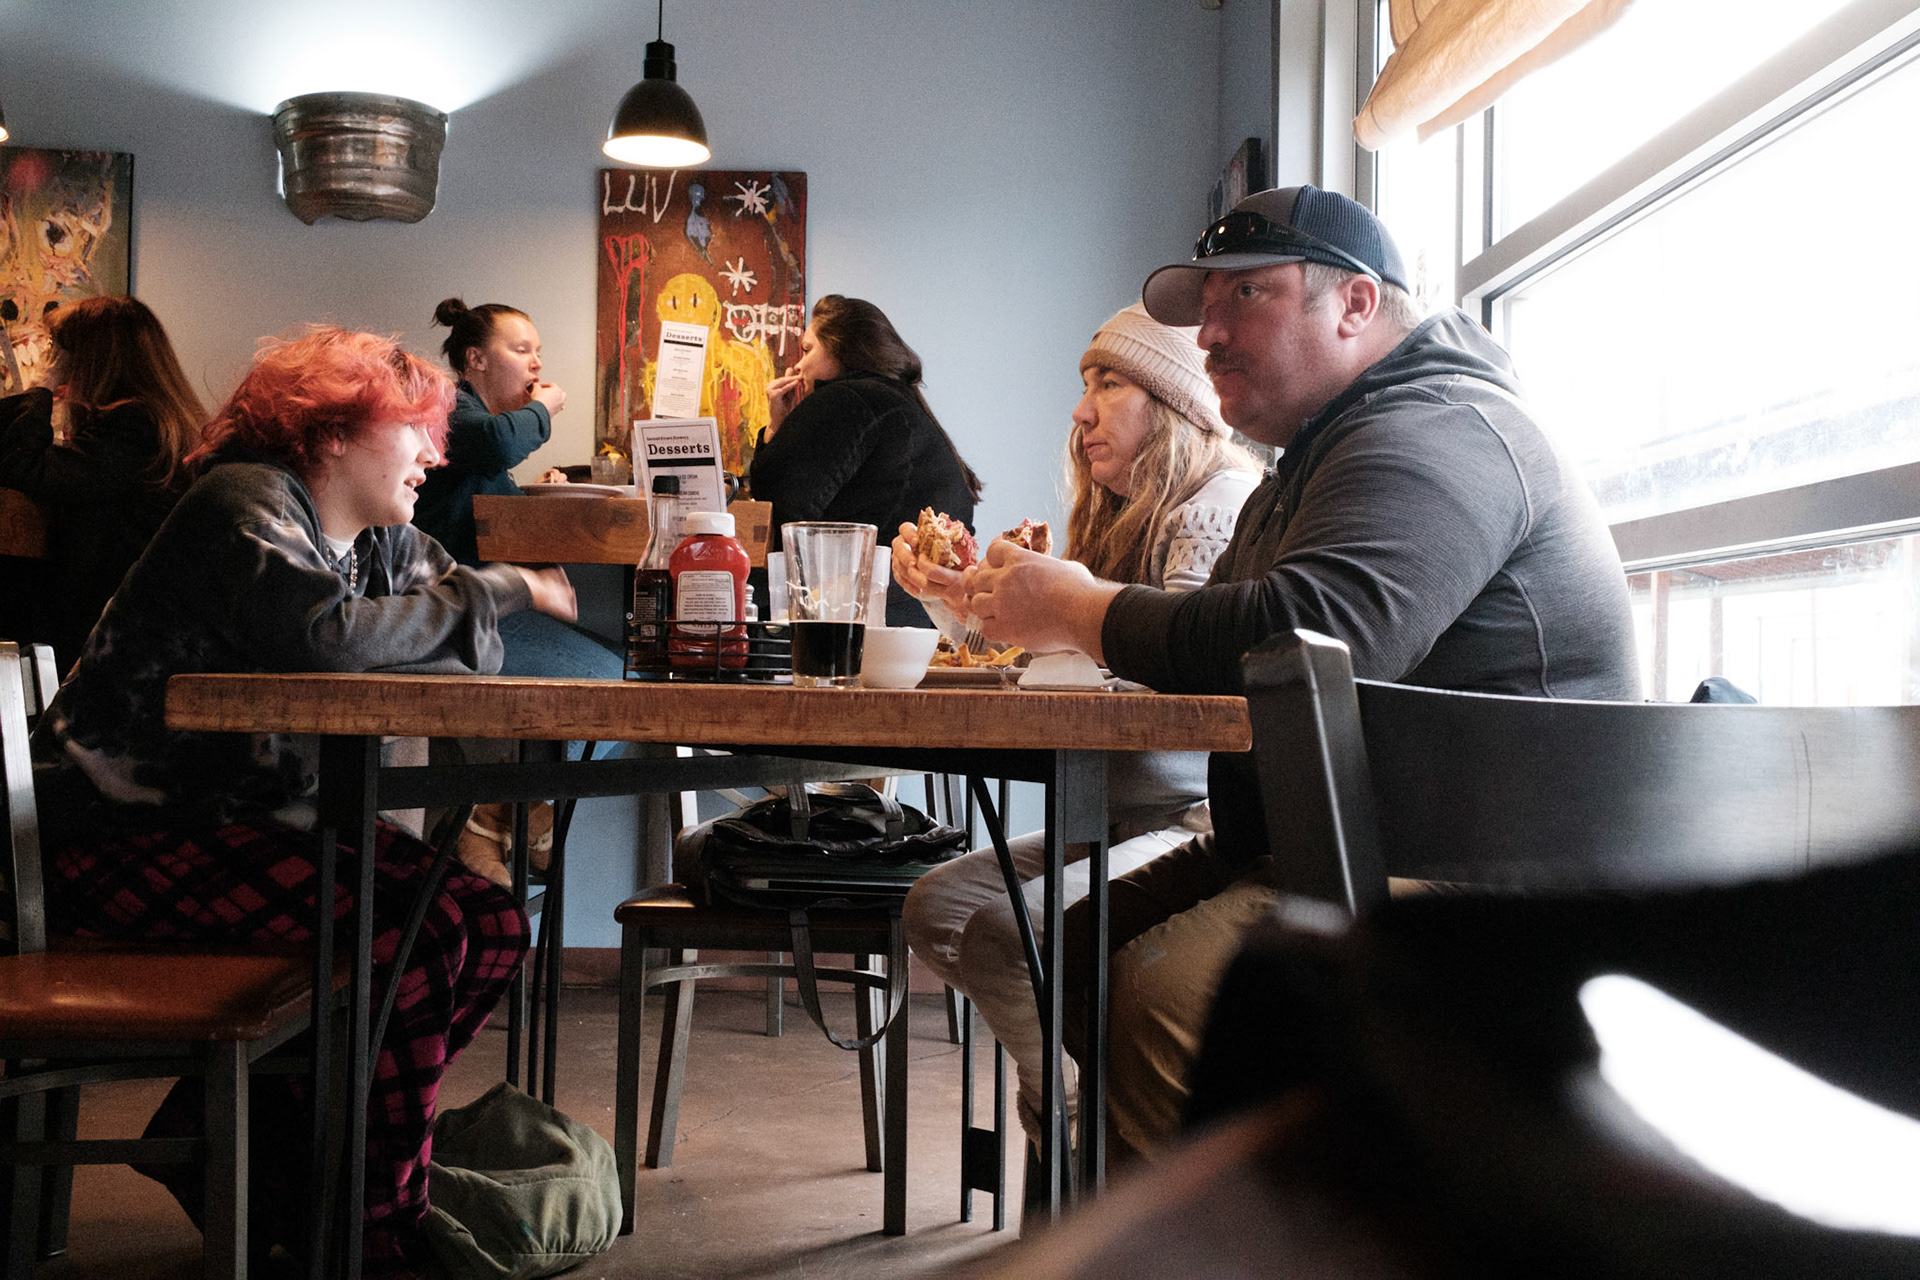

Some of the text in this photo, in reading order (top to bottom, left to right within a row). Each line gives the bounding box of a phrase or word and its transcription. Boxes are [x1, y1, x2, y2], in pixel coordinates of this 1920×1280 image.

[603, 170, 679, 224] LUV
[666, 332, 702, 342] Desserts
[648, 443, 710, 455] Desserts
